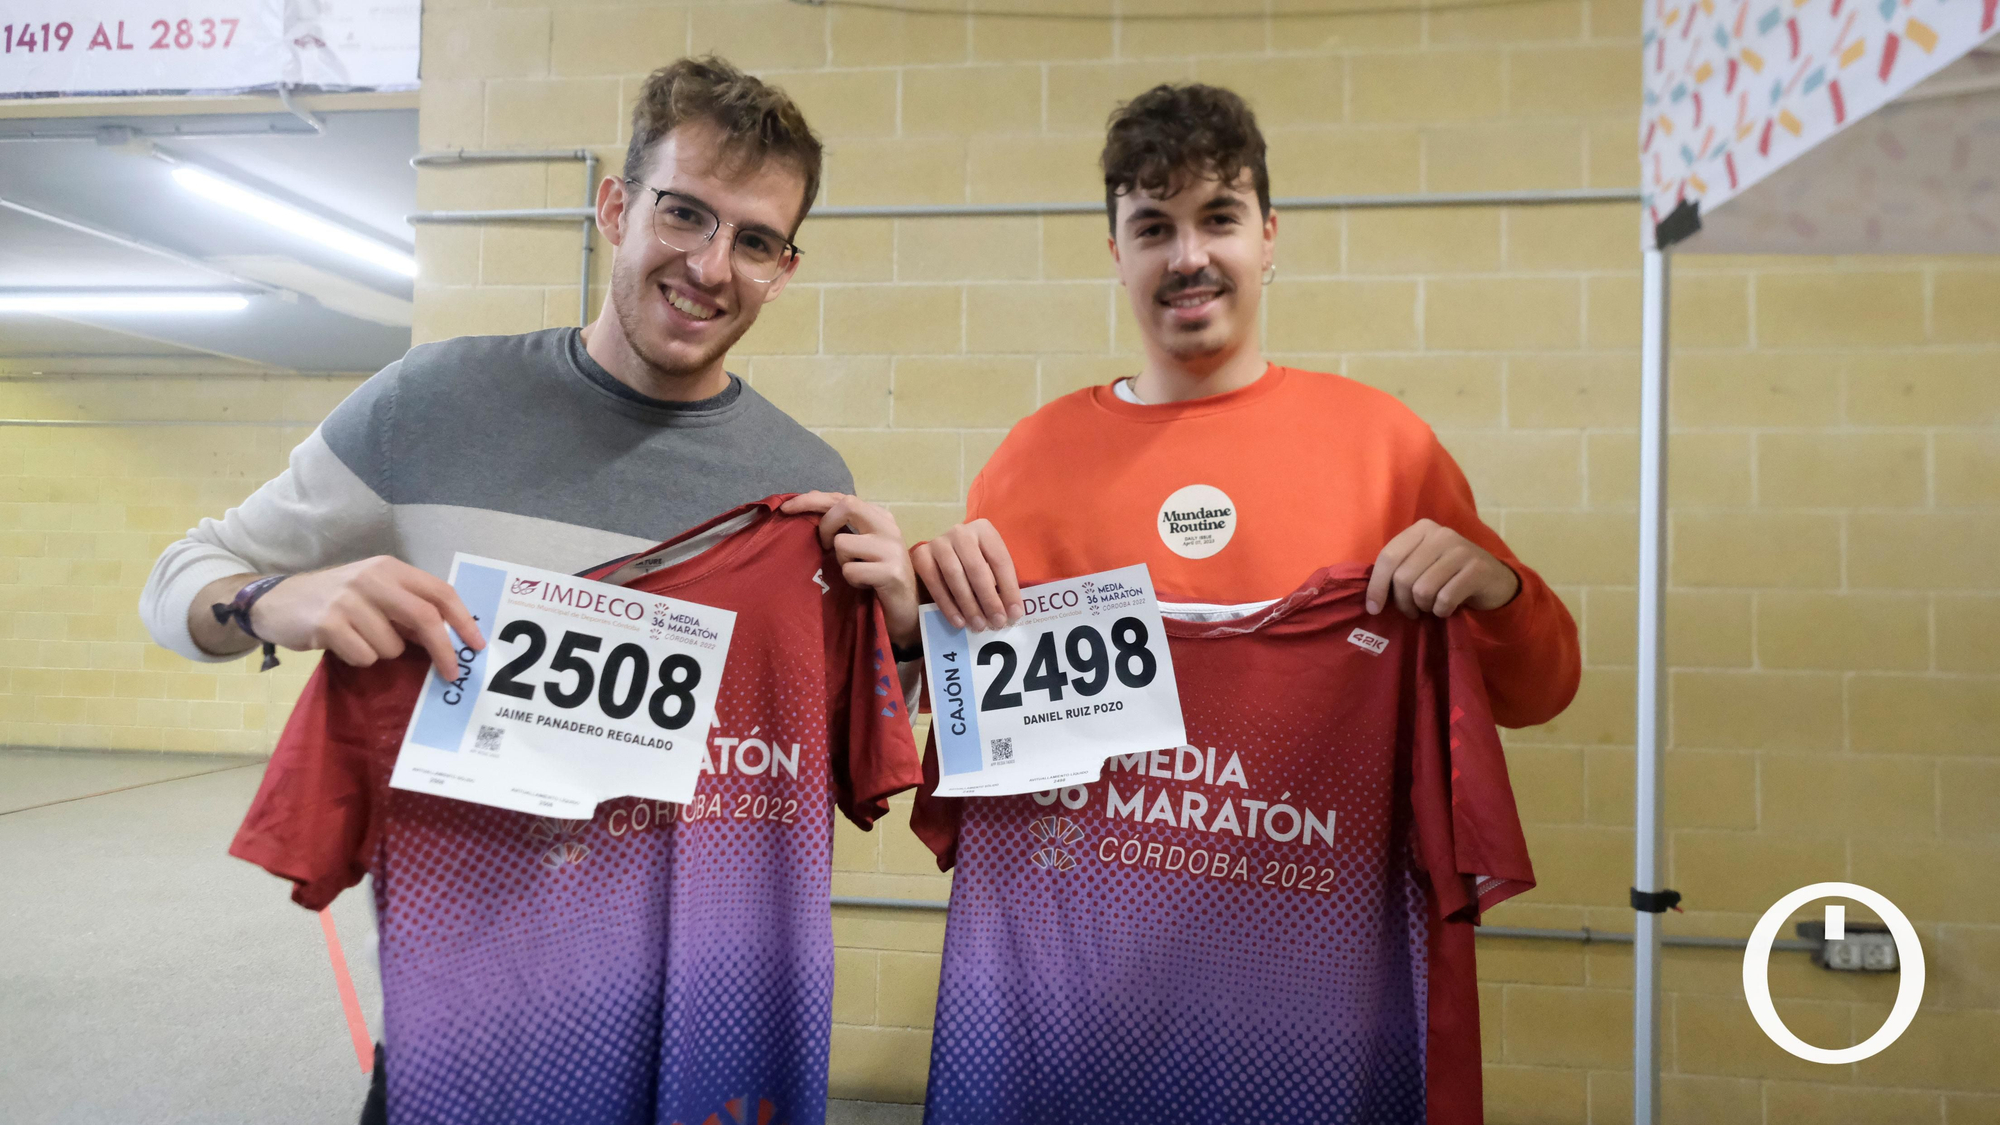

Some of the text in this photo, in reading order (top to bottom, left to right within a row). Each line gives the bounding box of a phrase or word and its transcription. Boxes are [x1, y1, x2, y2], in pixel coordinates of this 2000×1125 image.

[4, 18, 240, 53] 1419 AL 2837
[1163, 507, 1232, 522] Mundane
[1169, 520, 1226, 534] Routine
[542, 582, 645, 621] IMDECO
[1023, 590, 1079, 616] DECO
[1086, 587, 1143, 604] 36 MARATÓN
[1097, 582, 1124, 594] MEDIA
[651, 617, 718, 640] 36 MARATÓN
[670, 613, 700, 627] MEDIA
[1353, 633, 1384, 649] 42K
[487, 620, 702, 730] 2508
[976, 617, 1157, 712] 2498
[942, 651, 967, 736] CAJÓN 4
[1023, 700, 1124, 725] DANIEL RUIZ POZO
[495, 707, 674, 751] JAIME PANADERO REGALADO
[1109, 744, 1249, 790] MEDIA
[734, 794, 798, 824] 2022
[1106, 781, 1337, 848] MARATÓN
[1098, 834, 1336, 893] CÓRDOBA 2022
